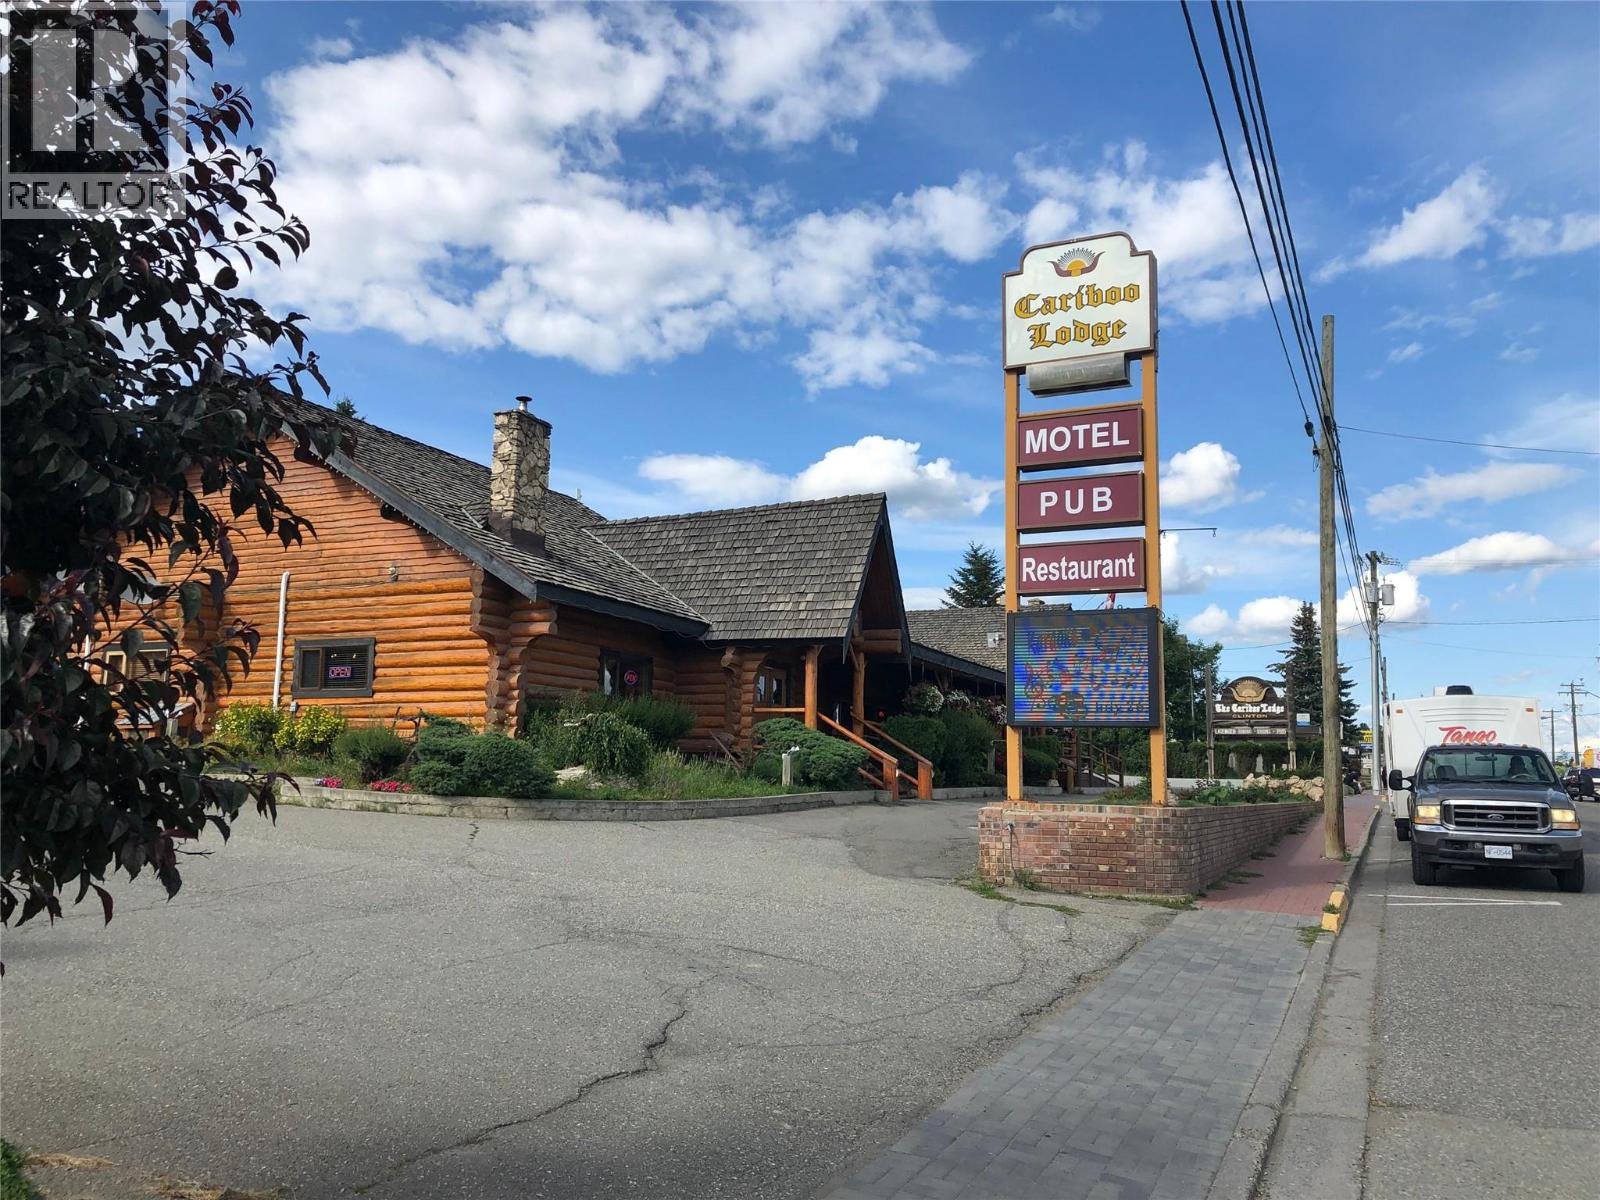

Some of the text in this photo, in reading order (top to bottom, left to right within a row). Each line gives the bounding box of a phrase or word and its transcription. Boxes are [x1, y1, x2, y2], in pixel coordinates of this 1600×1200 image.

[1014, 283, 1140, 319] Cariboo
[1027, 319, 1127, 350] Lodge
[1025, 421, 1130, 454] MOTEL
[1040, 487, 1113, 517] PUB
[1022, 552, 1135, 582] Restaurant
[329, 666, 351, 678] OPEN
[1215, 703, 1285, 714] The Cariboo Lodge
